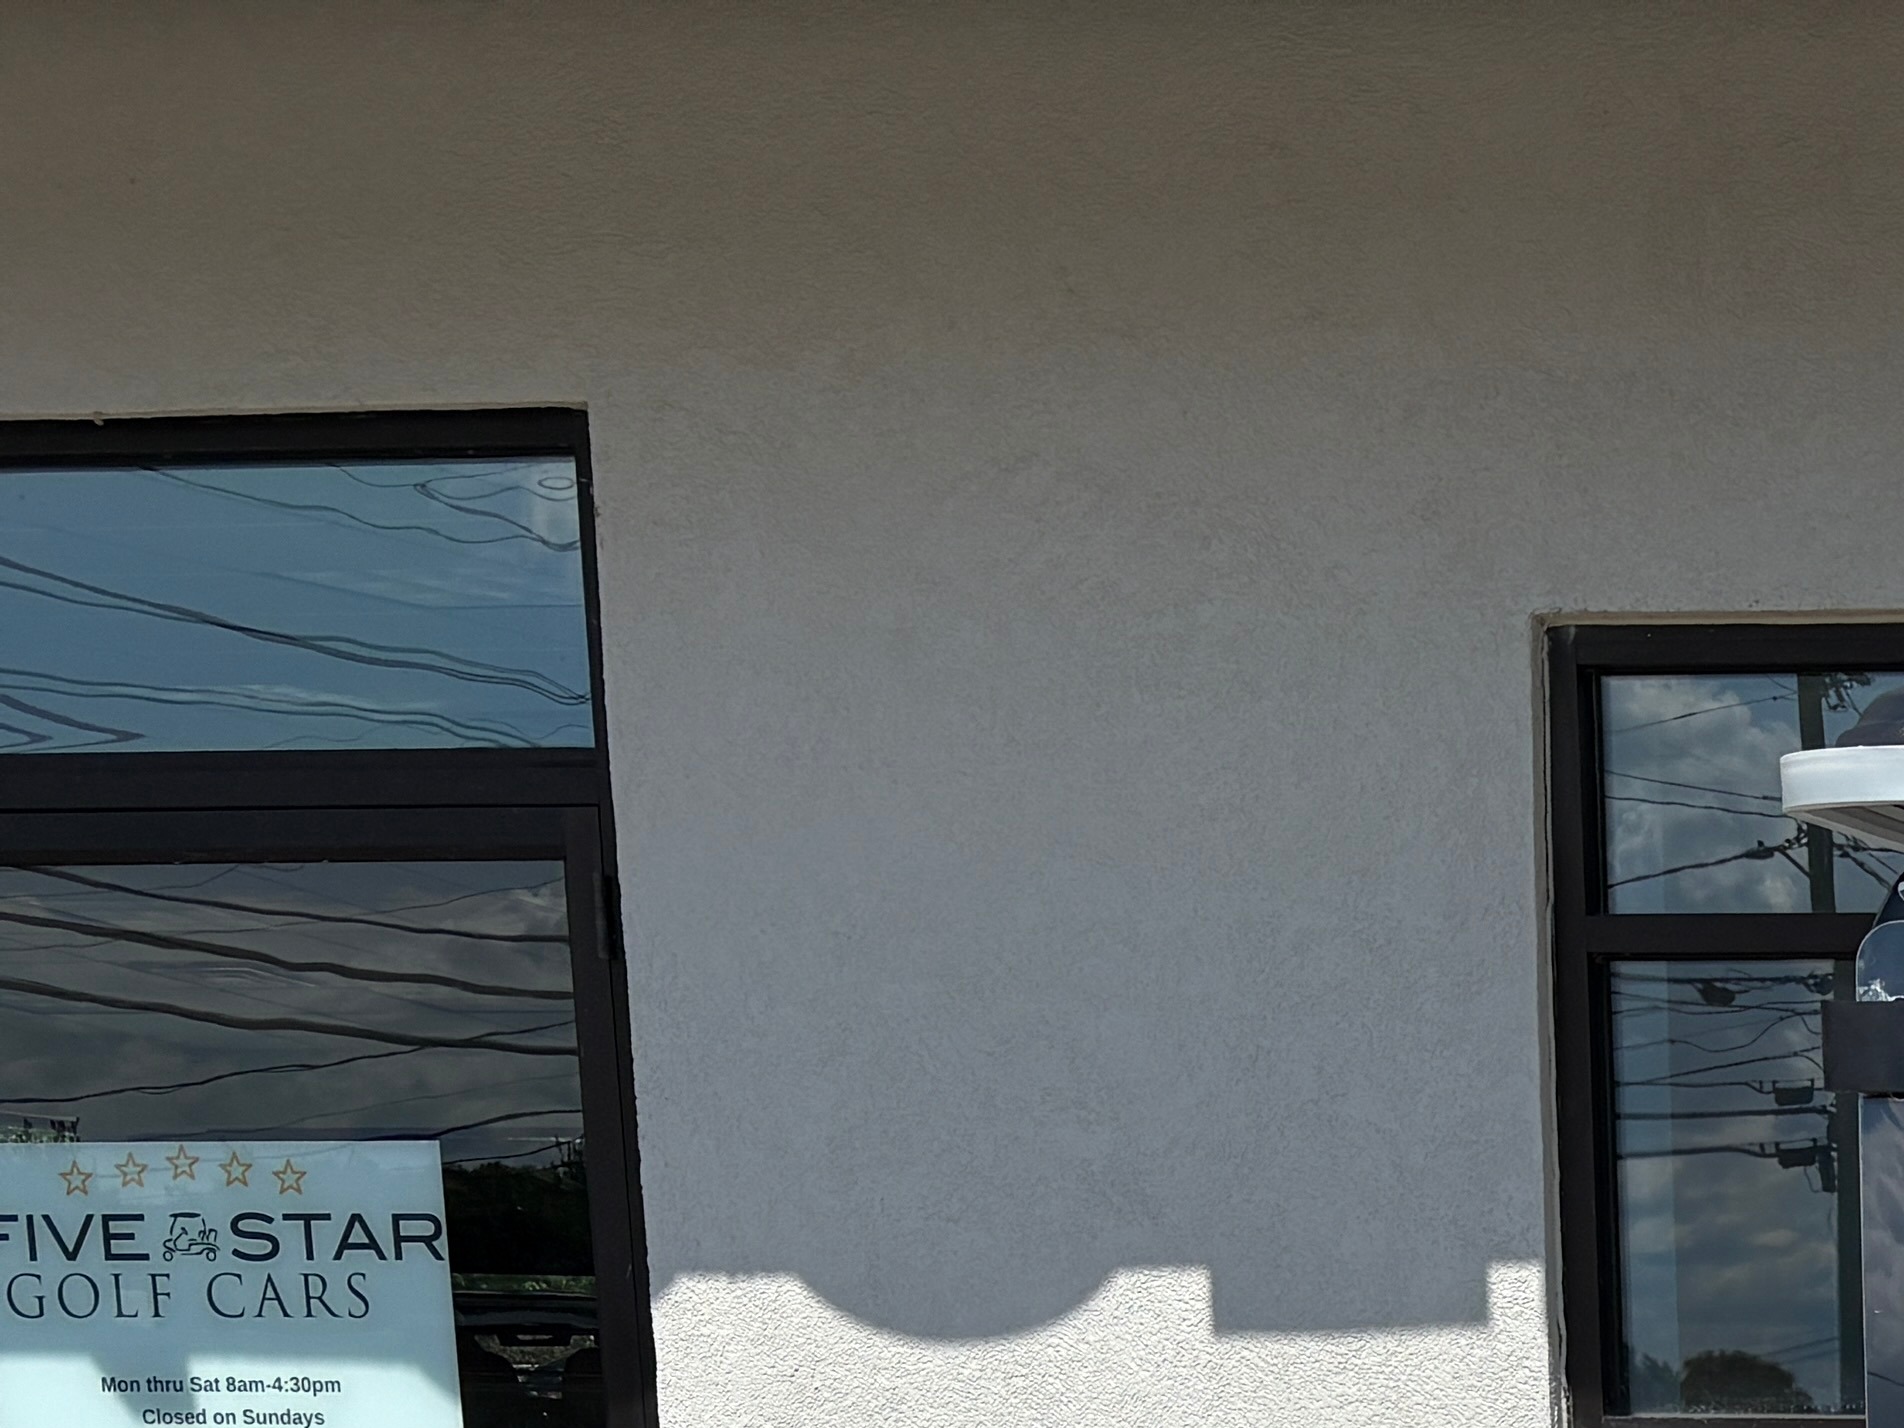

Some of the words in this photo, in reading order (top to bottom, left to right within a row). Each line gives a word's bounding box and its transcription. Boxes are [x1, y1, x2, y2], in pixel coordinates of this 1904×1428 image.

[0, 1213, 150, 1262] IVE
[229, 1211, 446, 1263] STAR
[6, 1272, 172, 1320] GOLF
[206, 1272, 370, 1320] CARS
[100, 1376, 141, 1393] Mon
[145, 1376, 184, 1393] thru
[189, 1376, 221, 1393] Sat
[225, 1376, 342, 1397] 8am-4:30pm
[142, 1408, 207, 1425] Closed
[213, 1412, 237, 1425] on
[242, 1408, 326, 1428] Sundays
